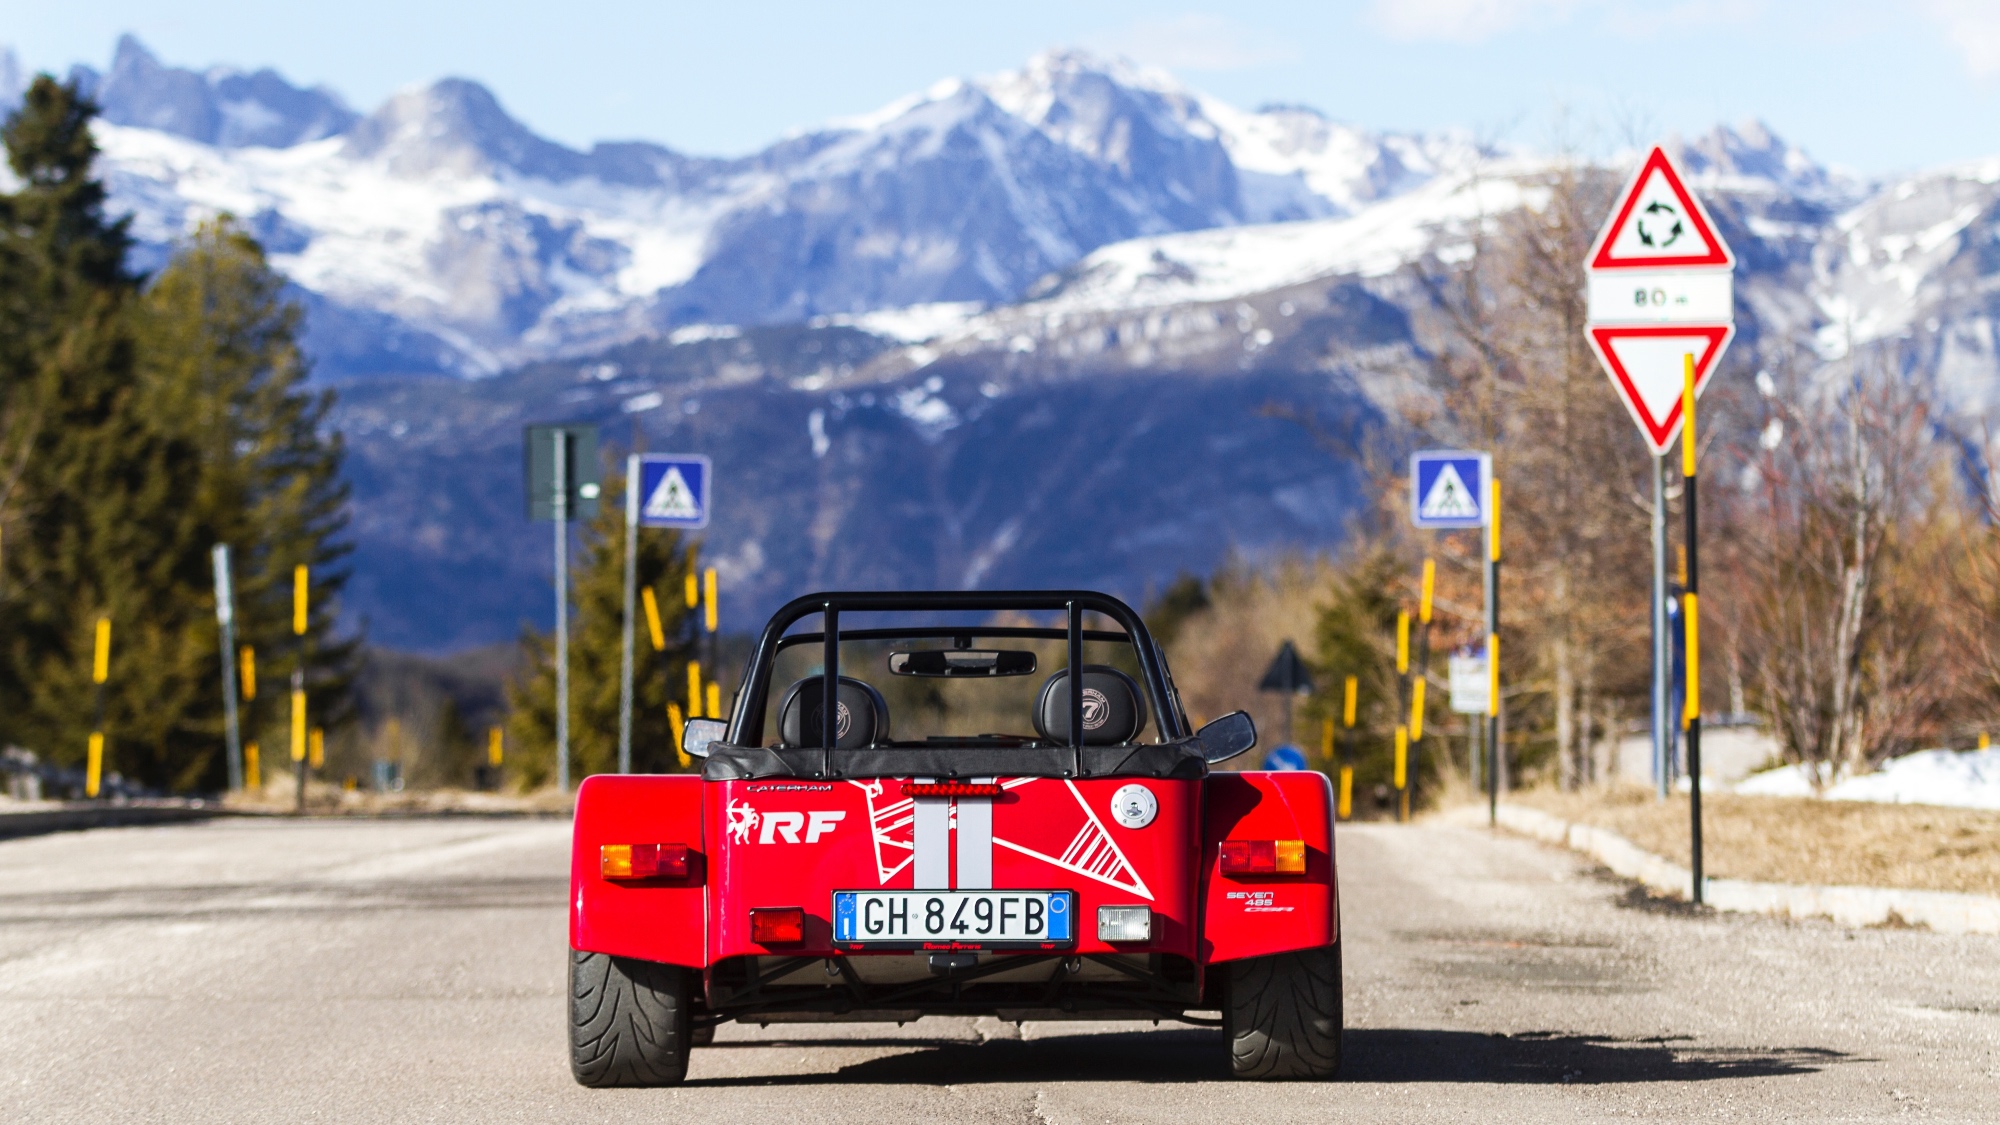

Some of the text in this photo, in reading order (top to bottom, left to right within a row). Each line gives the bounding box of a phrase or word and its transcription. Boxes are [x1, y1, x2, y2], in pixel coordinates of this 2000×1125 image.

[1634, 287, 1667, 307] 80
[1082, 701, 1099, 719] 7
[746, 784, 833, 793] CATERHAM
[759, 811, 847, 844] RF
[864, 897, 1045, 935] GH 849FB
